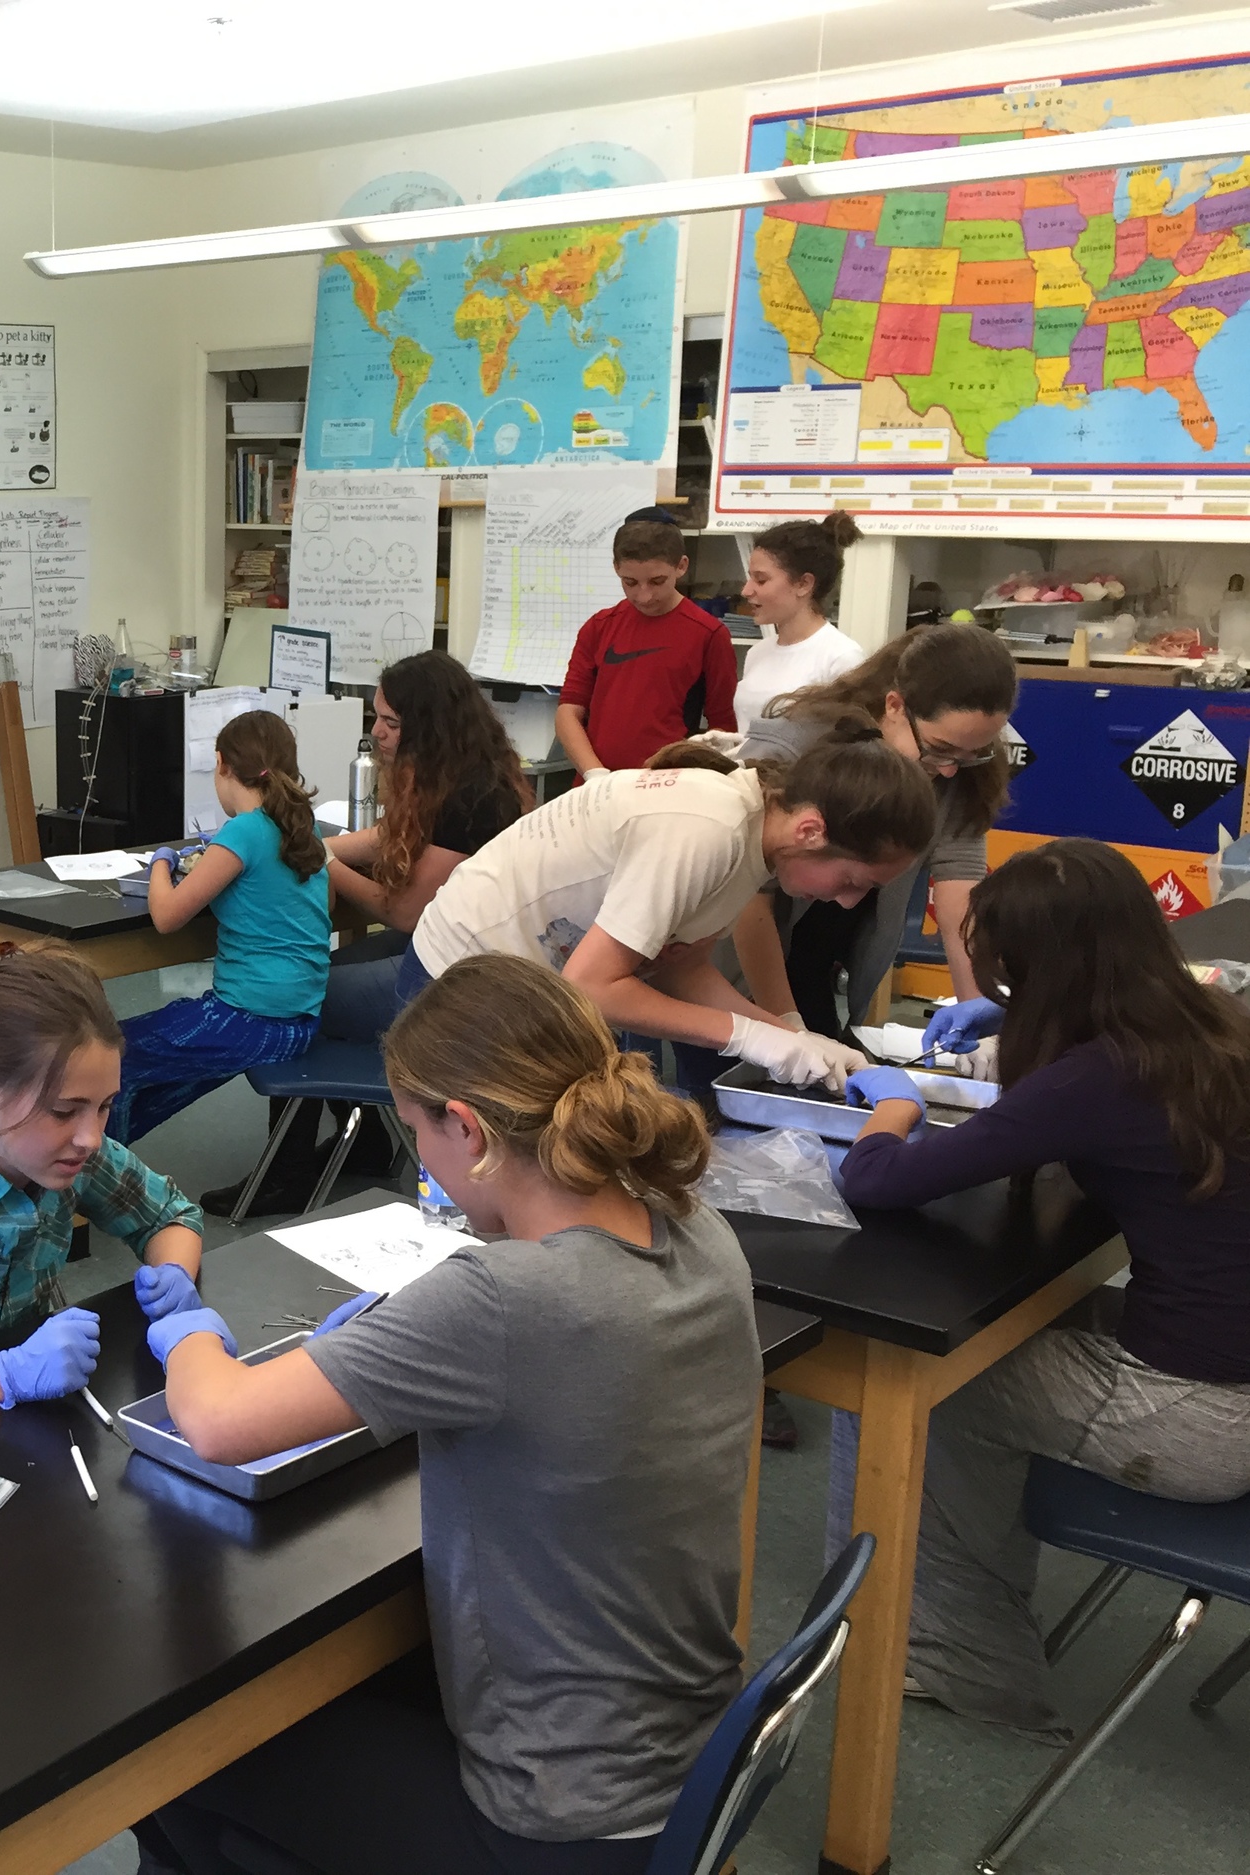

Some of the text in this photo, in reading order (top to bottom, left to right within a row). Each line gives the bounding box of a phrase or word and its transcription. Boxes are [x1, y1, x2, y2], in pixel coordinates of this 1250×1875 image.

[1002, 98, 1063, 112] Canada
[1126, 163, 1169, 179] Michigan
[1218, 178, 1240, 189] New
[895, 207, 937, 219] Wyoming
[1038, 220, 1065, 229] Iowa
[1156, 222, 1183, 234] Ohio
[963, 231, 1014, 242] Nebraska
[801, 252, 835, 264] Nevada
[852, 262, 876, 273] Utah
[976, 278, 1016, 287] Kansas
[1041, 281, 1082, 292] Missouri
[1120, 274, 1166, 289] Kentucky
[769, 300, 812, 315] California
[1098, 302, 1148, 315] Tennessee
[980, 317, 1025, 327] Oklahoma
[1038, 321, 1079, 331] Arkansas
[6, 330, 22, 344] pet
[23, 333, 29, 341] a
[30, 329, 52, 344] kitty
[831, 330, 865, 342] Arizona
[880, 333, 898, 341] New
[1147, 334, 1185, 347] Georgia
[1106, 346, 1143, 356] Alabama
[949, 382, 996, 392] Texas
[1041, 385, 1080, 395] Louisiana
[879, 420, 924, 429] Mexico
[1180, 415, 1216, 427] Florida
[1130, 755, 1238, 784] CORROSIVE
[1172, 802, 1186, 820] 8
